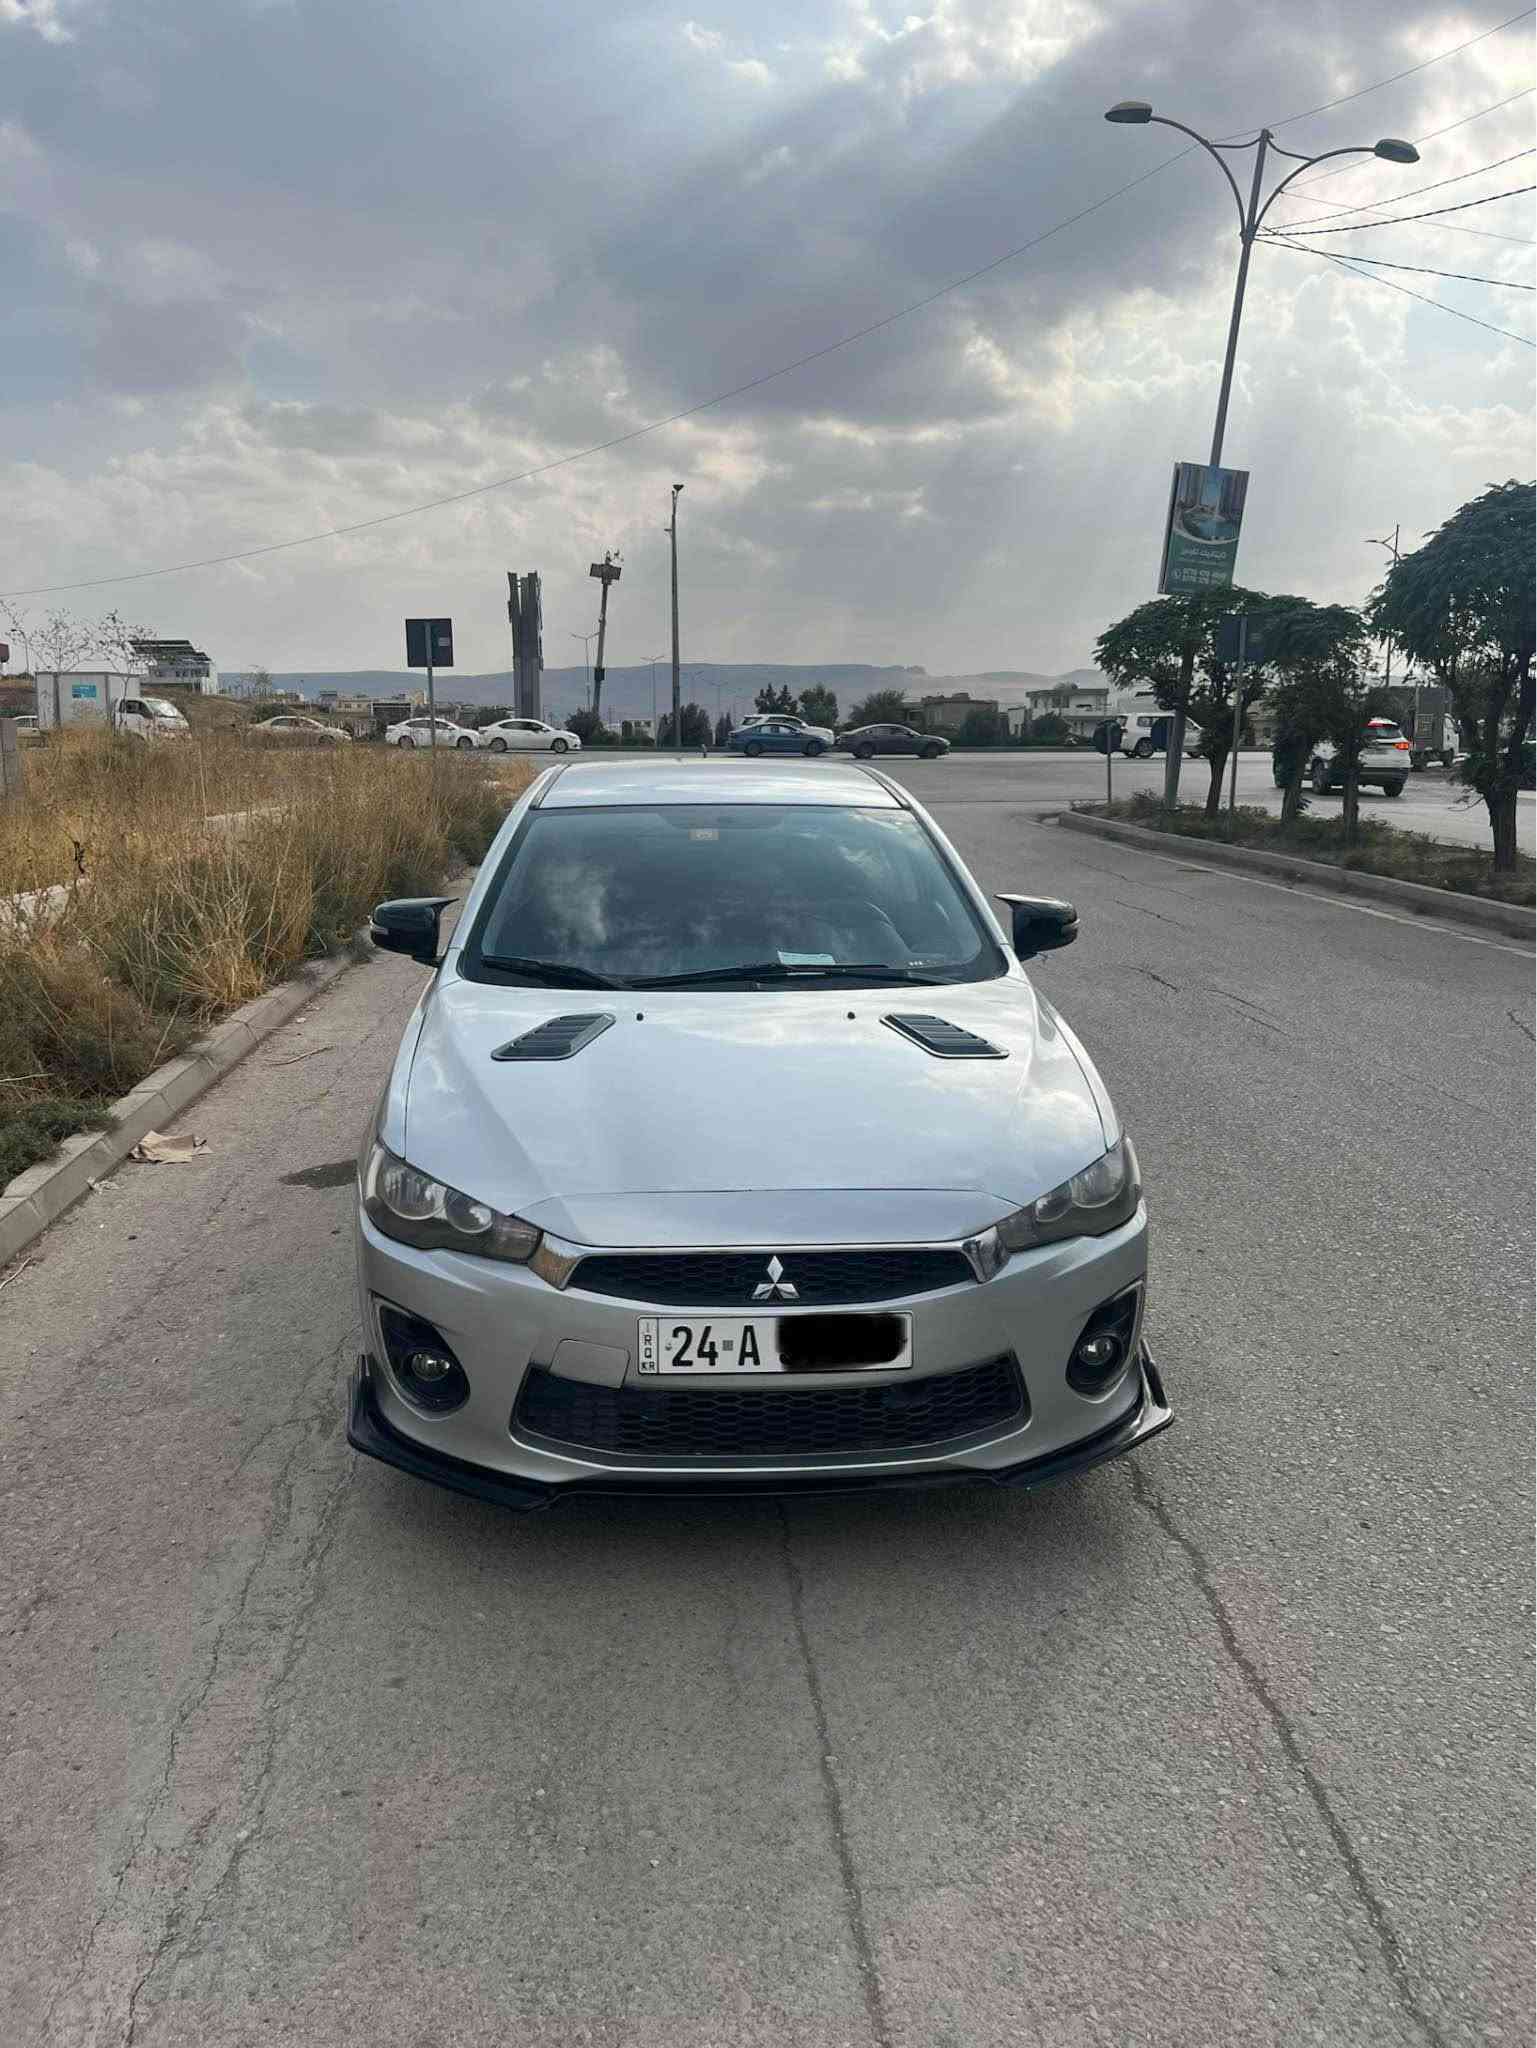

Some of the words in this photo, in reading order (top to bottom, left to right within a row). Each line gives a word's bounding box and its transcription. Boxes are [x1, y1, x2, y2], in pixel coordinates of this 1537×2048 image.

[672, 1325, 718, 1366] 24
[738, 1325, 760, 1366] A
[641, 1361, 655, 1371] KR
